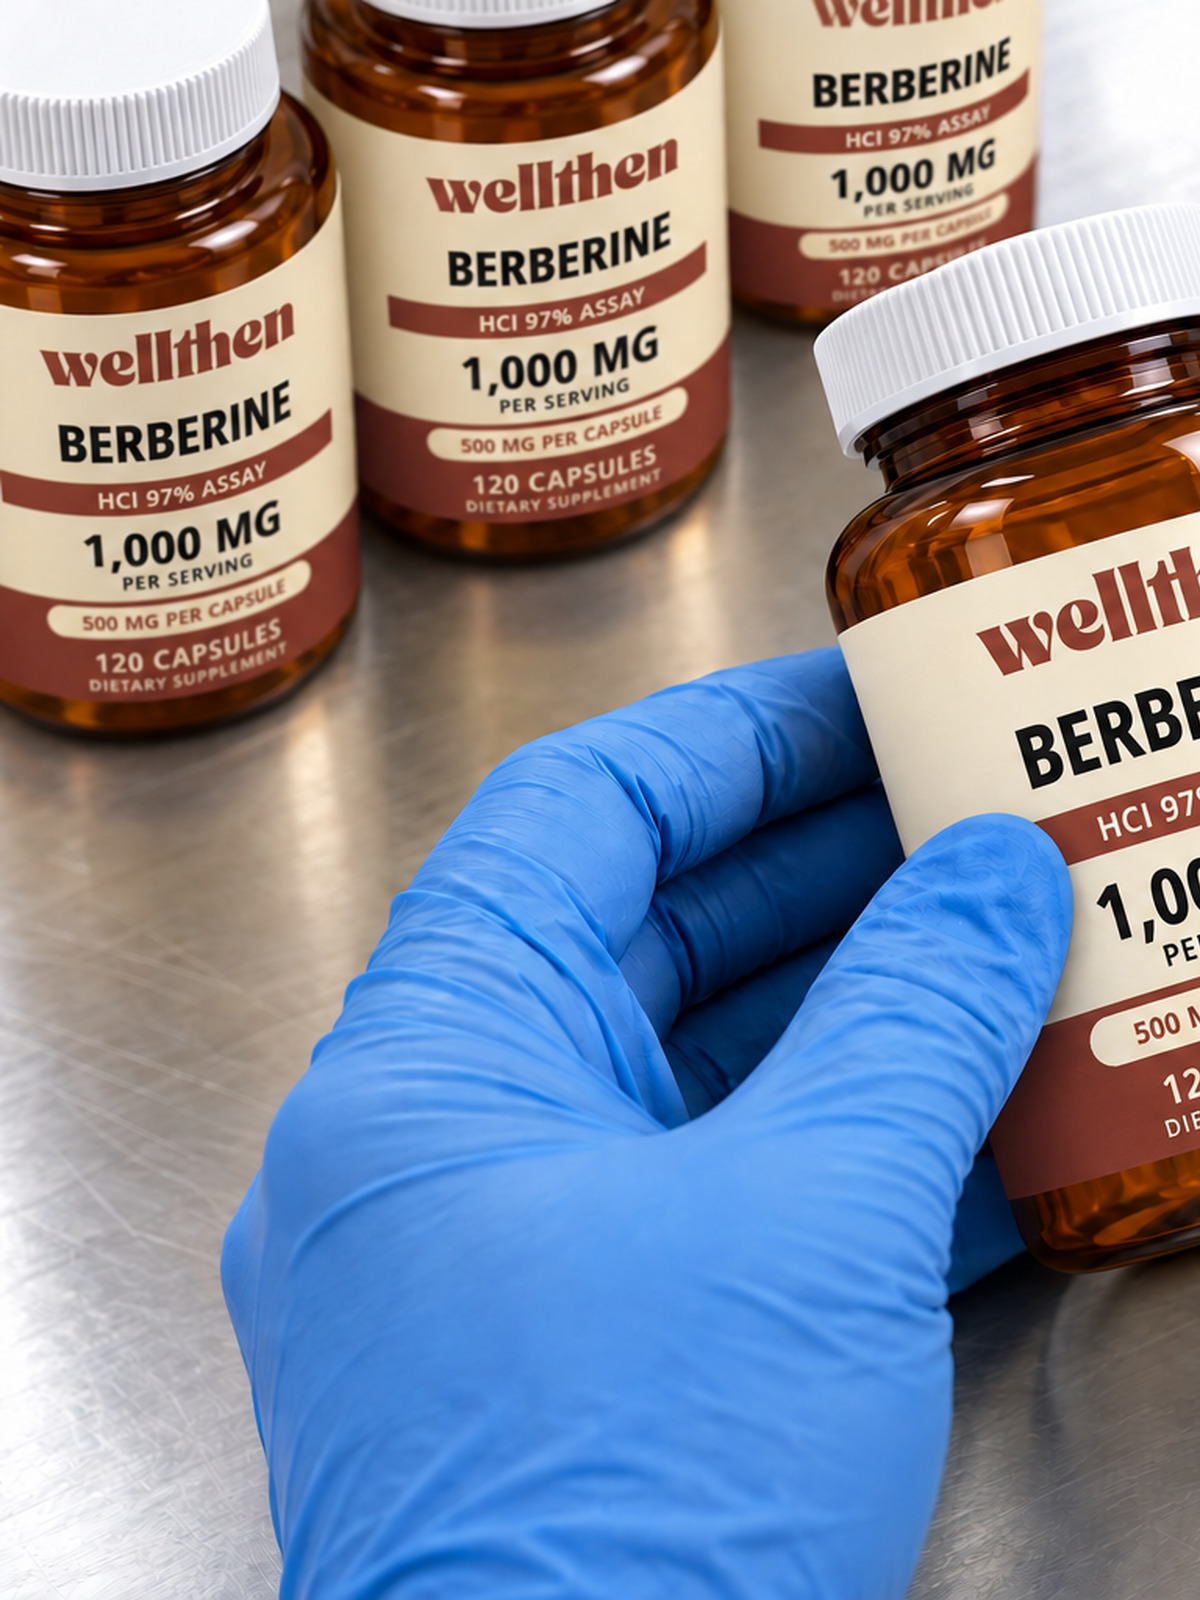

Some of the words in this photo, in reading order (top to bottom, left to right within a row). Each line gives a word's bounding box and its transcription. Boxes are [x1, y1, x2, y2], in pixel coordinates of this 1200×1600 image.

[813, 37, 1011, 108] BERBERINE
[888, 125, 932, 144] 97%
[937, 106, 990, 135] ASSAY
[425, 138, 679, 213] wellthen
[831, 159, 933, 203] 1,000
[947, 138, 996, 182] MG
[864, 203, 896, 217] PER
[904, 184, 974, 212] SERVING
[447, 211, 672, 287] BERBERINE
[829, 239, 860, 252] 500
[866, 236, 895, 249] MG
[901, 229, 932, 244] PER
[839, 267, 880, 285] 120
[526, 308, 573, 331] 97%
[579, 287, 646, 321] ASSAY
[40, 303, 295, 387] wellthen
[462, 349, 577, 397] 1,000
[593, 324, 659, 377] MG
[499, 398, 537, 413] PER
[544, 378, 631, 411] SERVING
[58, 380, 292, 463] BERBERINE
[460, 438, 495, 454] 500
[502, 436, 535, 453] MG
[542, 433, 578, 450] PER
[584, 405, 663, 442] CAPSULE
[147, 484, 195, 507] 97%
[202, 461, 267, 497] ASSAY
[465, 497, 540, 514] DIETARY
[547, 469, 662, 511] SUPPLEMENT
[473, 473, 520, 494] 120
[529, 444, 657, 492] CAPSULES
[83, 526, 201, 574] 1,000
[216, 499, 282, 553] MG
[122, 574, 160, 591] PER
[168, 553, 254, 587] SERVING
[82, 615, 118, 632] 500
[125, 613, 159, 631] MG
[167, 609, 202, 627] PER
[208, 579, 287, 619] CAPSULE
[89, 675, 166, 694] DIETARY
[173, 643, 288, 690] SUPPLEMENT
[95, 651, 144, 674] 120
[153, 618, 282, 671] CAPSULES
[1133, 1011, 1181, 1046] 500
